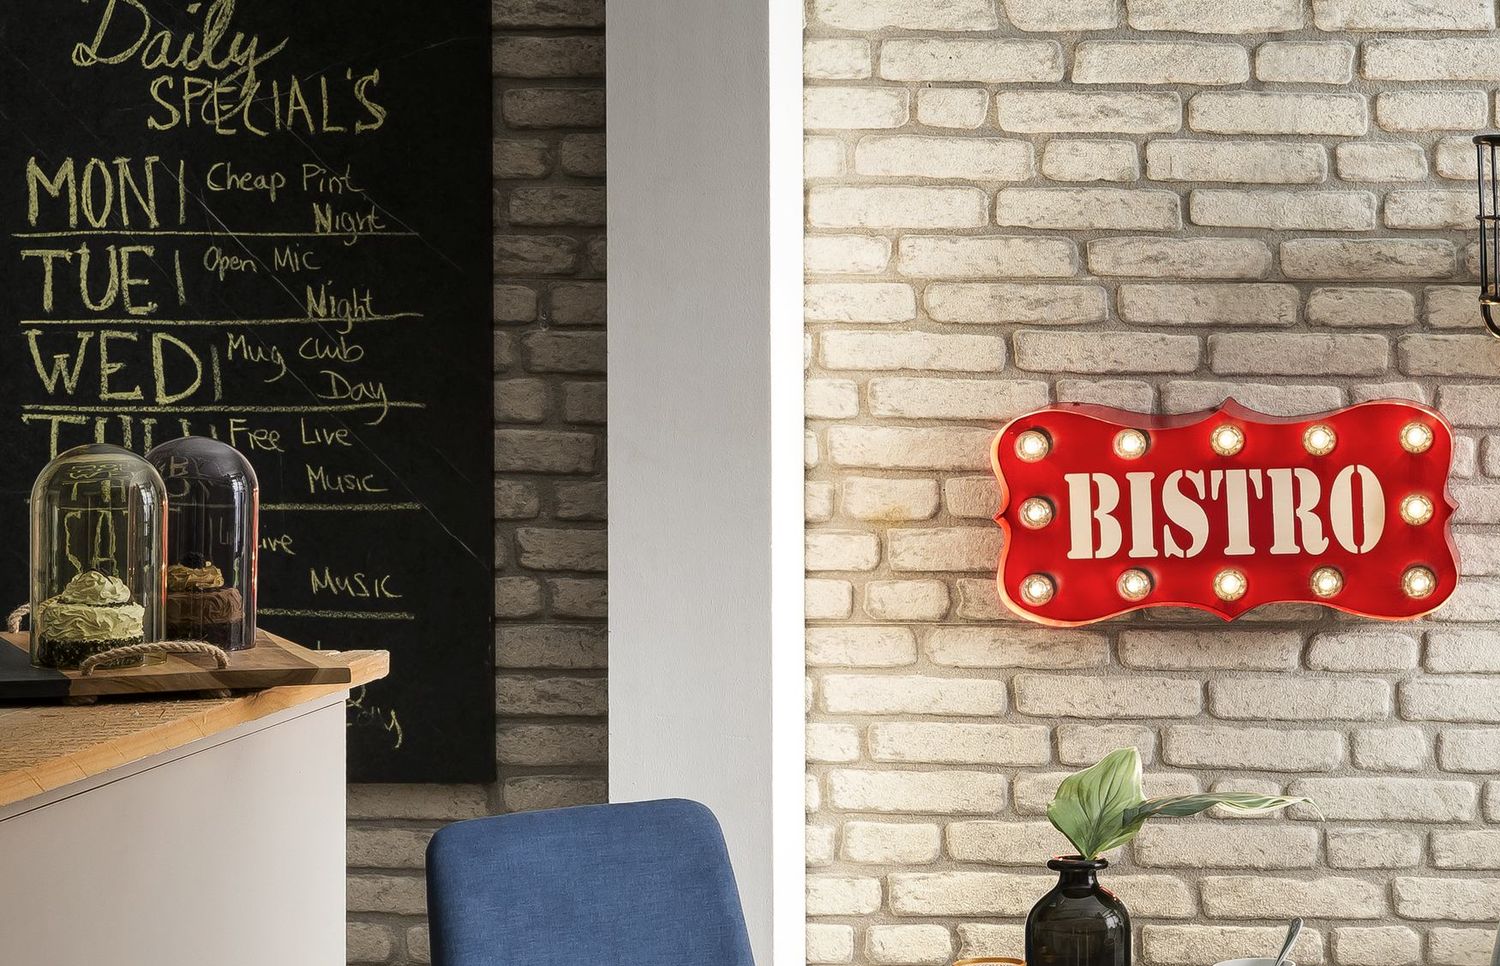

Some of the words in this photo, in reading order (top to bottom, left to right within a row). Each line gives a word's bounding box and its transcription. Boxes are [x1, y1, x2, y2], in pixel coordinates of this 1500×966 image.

[73, 0, 289, 112] Daily
[148, 68, 389, 136] SPECIAL'S
[26, 156, 160, 228] MON
[206, 162, 286, 202] Cheap
[302, 163, 366, 194] Pint
[314, 203, 386, 246] Night
[20, 242, 158, 315] TUE
[204, 246, 257, 281] Open
[273, 244, 322, 271] Mic
[305, 280, 376, 333] Night
[21, 329, 203, 404] WED
[227, 332, 286, 382] Mug
[319, 370, 389, 425] Day
[229, 418, 284, 452] Free
[300, 417, 353, 447] Live
[305, 463, 389, 494] Music
[1064, 464, 1386, 560] BISTRO
[258, 534, 296, 556] ive
[309, 566, 403, 598] Music
